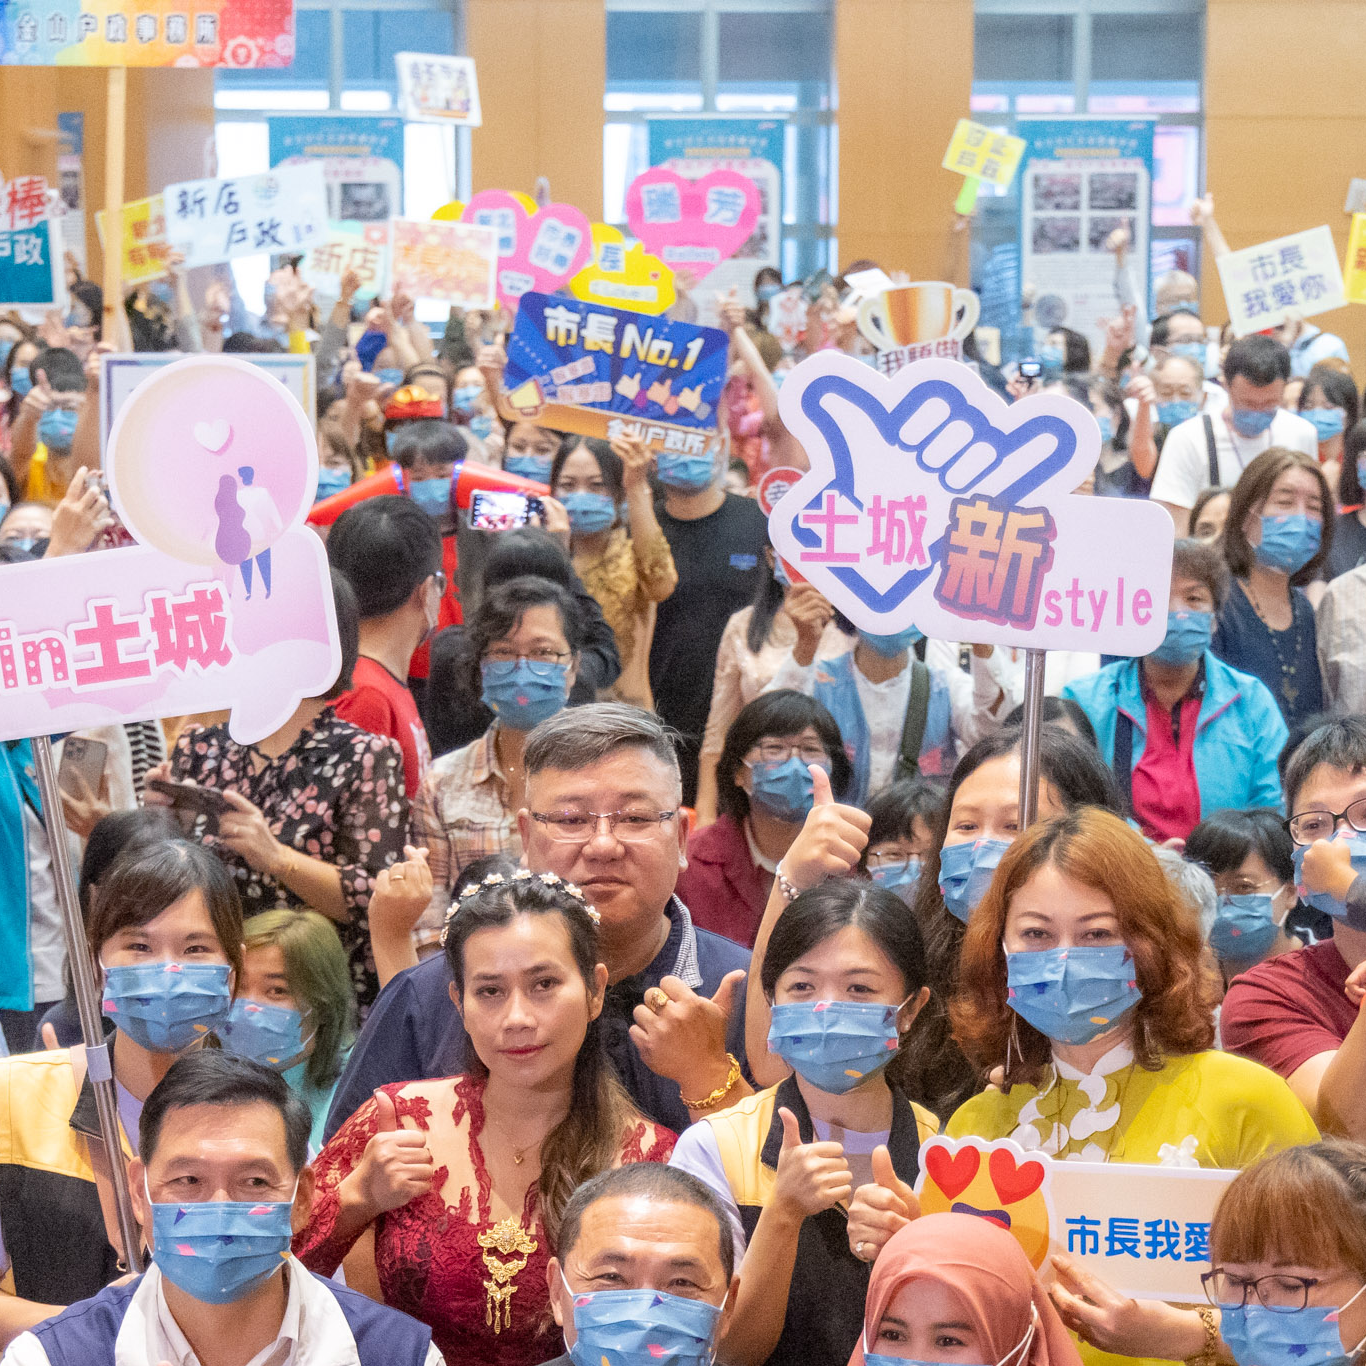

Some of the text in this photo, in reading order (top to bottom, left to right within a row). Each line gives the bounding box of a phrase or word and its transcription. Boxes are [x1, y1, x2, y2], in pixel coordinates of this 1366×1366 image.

[176, 183, 239, 219] 新店
[224, 217, 283, 254] 戶政
[1249, 245, 1307, 283] 市長
[800, 492, 1154, 632] 土城 新 style
[1064, 1215, 1212, 1263] 市長我愛
